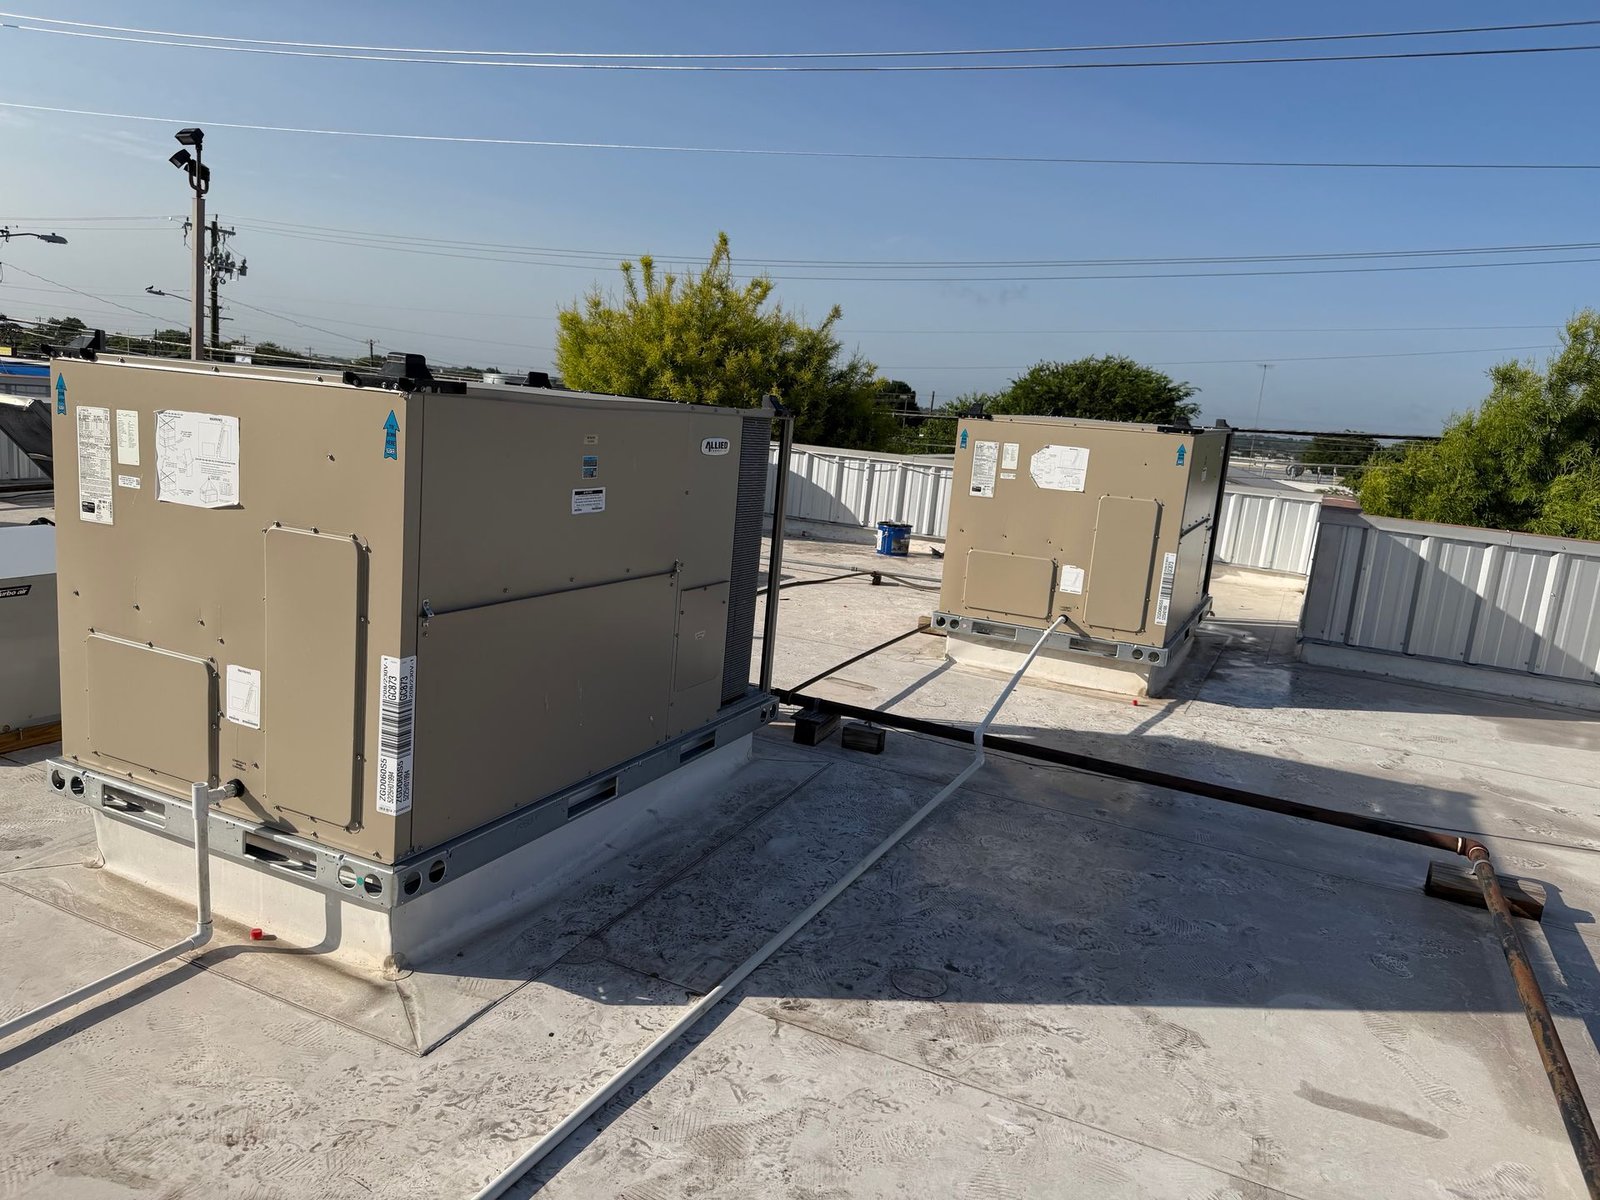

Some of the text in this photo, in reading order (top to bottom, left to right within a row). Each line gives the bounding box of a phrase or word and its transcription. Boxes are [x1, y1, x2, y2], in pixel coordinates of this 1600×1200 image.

[705, 441, 729, 452] ALLIED
[388, 675, 397, 701] GC873
[399, 675, 408, 701] GC873
[379, 758, 387, 802] ZGD060S5
